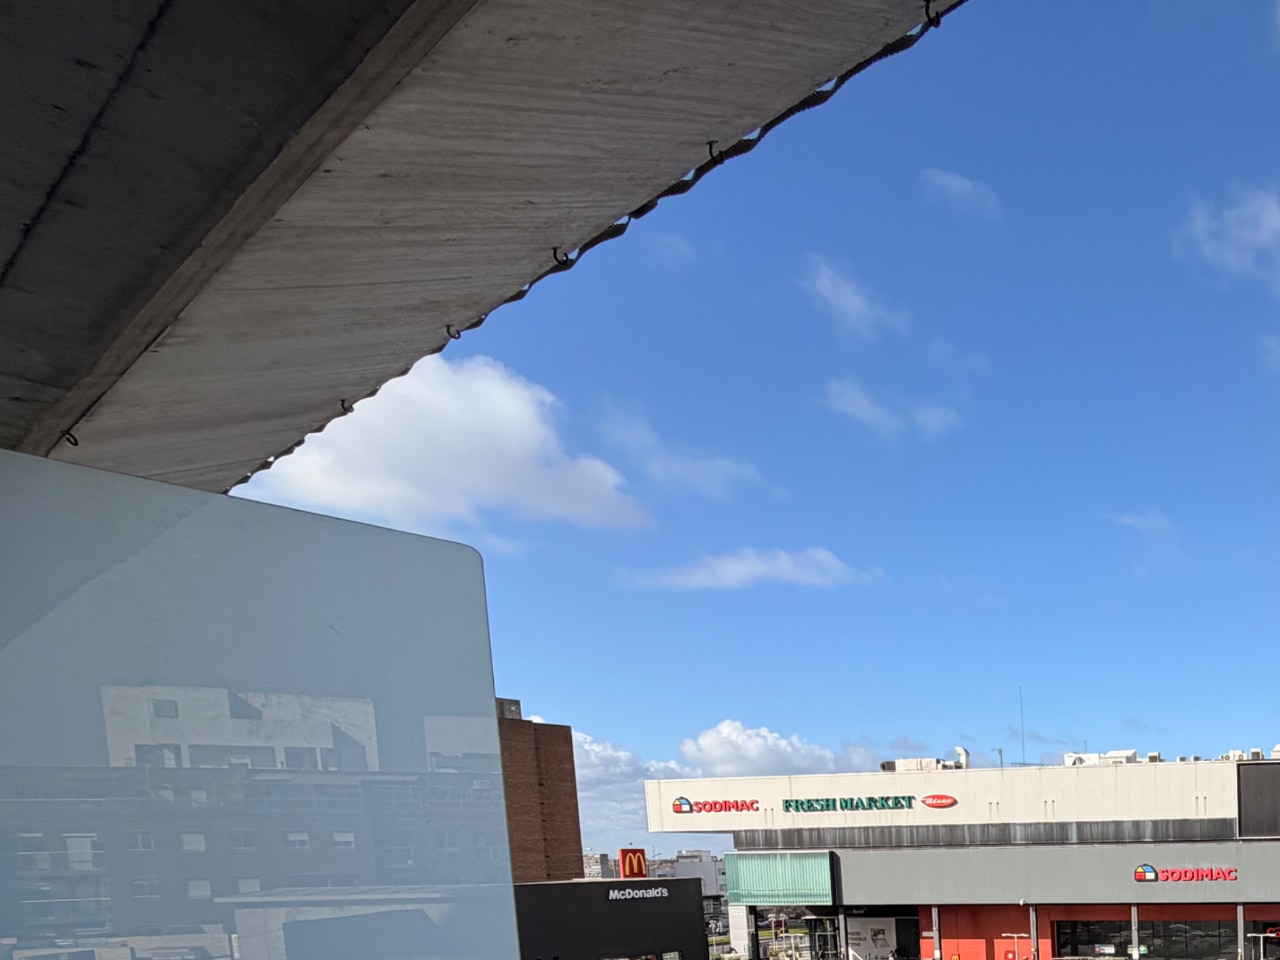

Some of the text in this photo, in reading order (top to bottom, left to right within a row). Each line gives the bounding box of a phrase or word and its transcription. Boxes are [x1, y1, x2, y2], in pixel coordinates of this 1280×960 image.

[693, 800, 760, 813] SODIMAC
[782, 795, 917, 813] FRESH MARKET
[1158, 867, 1238, 881] SODIMAC
[608, 887, 669, 900] McDonald's
